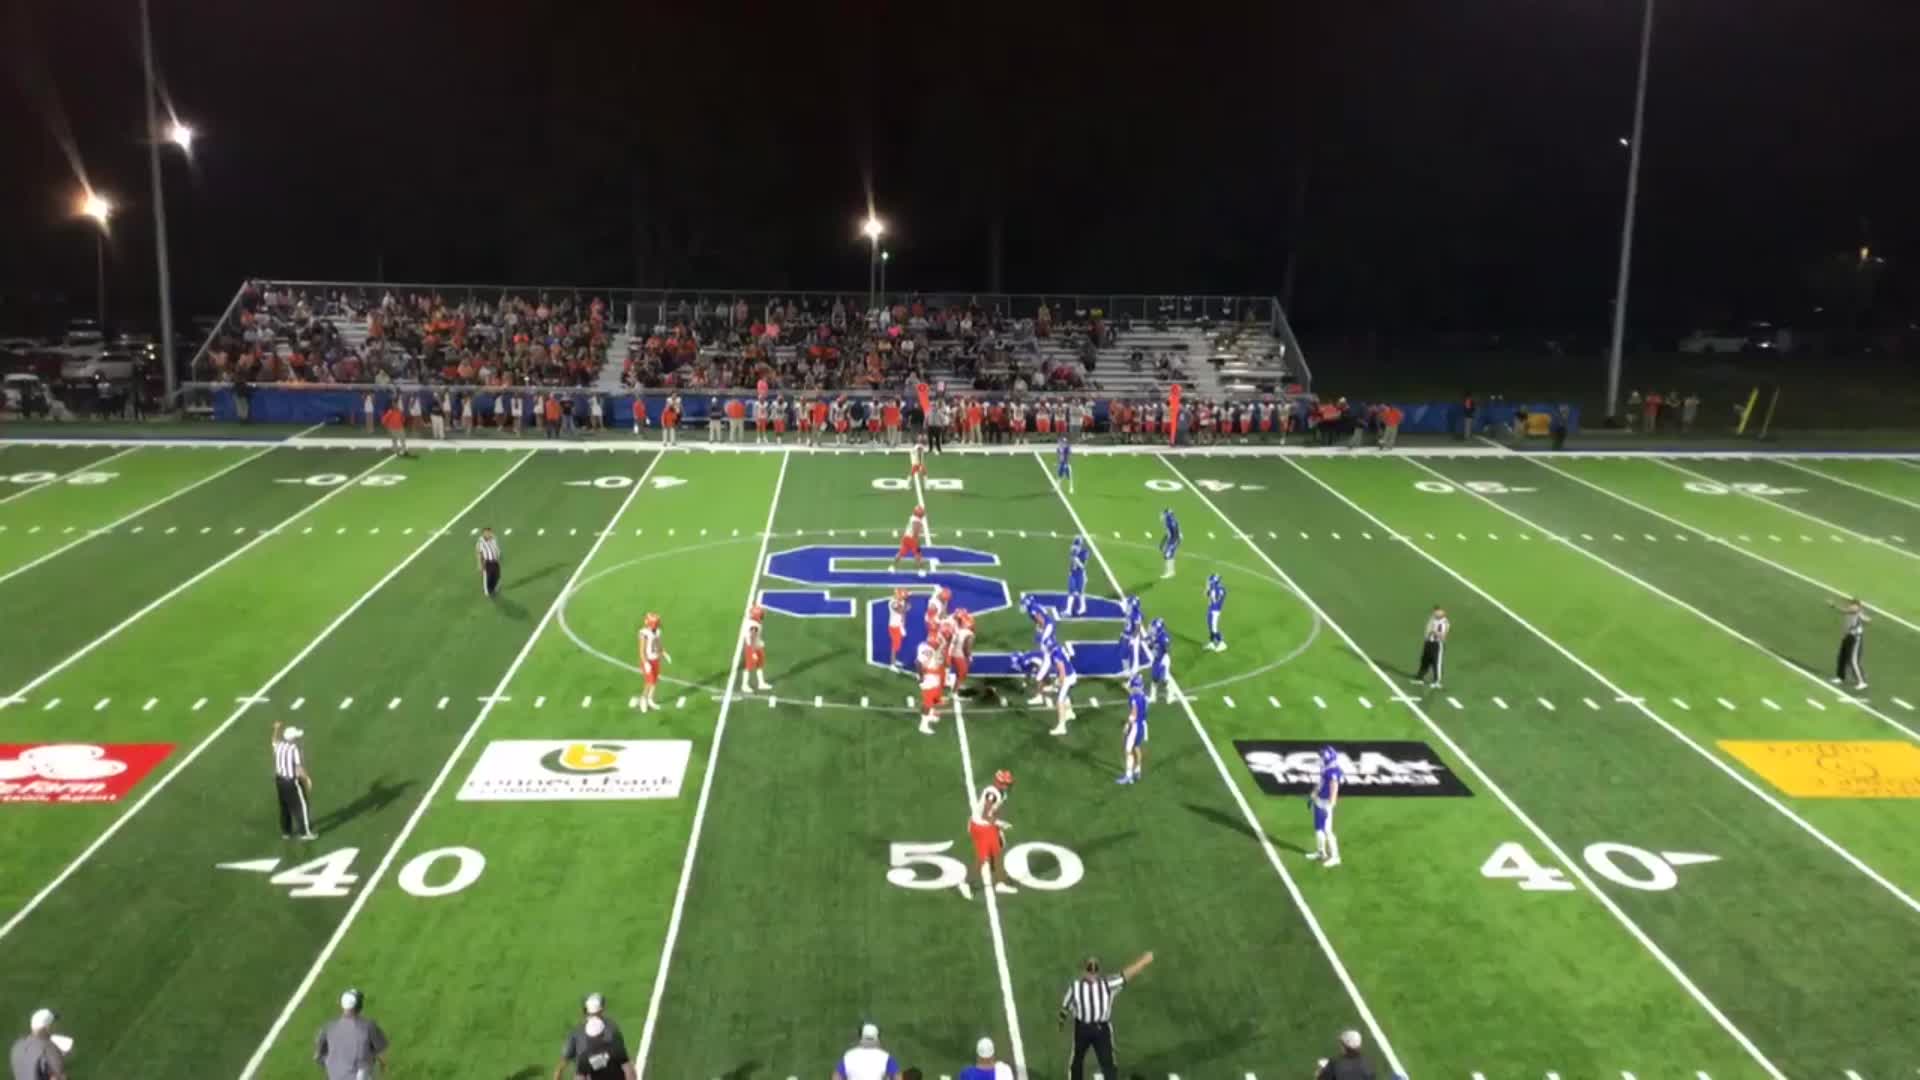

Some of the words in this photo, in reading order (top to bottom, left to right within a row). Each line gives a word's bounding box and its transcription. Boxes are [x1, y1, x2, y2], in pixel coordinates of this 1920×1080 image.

[872, 478, 963, 491] 50
[271, 847, 485, 897] 40
[886, 842, 1084, 890] 50
[1481, 843, 1676, 890] 40
